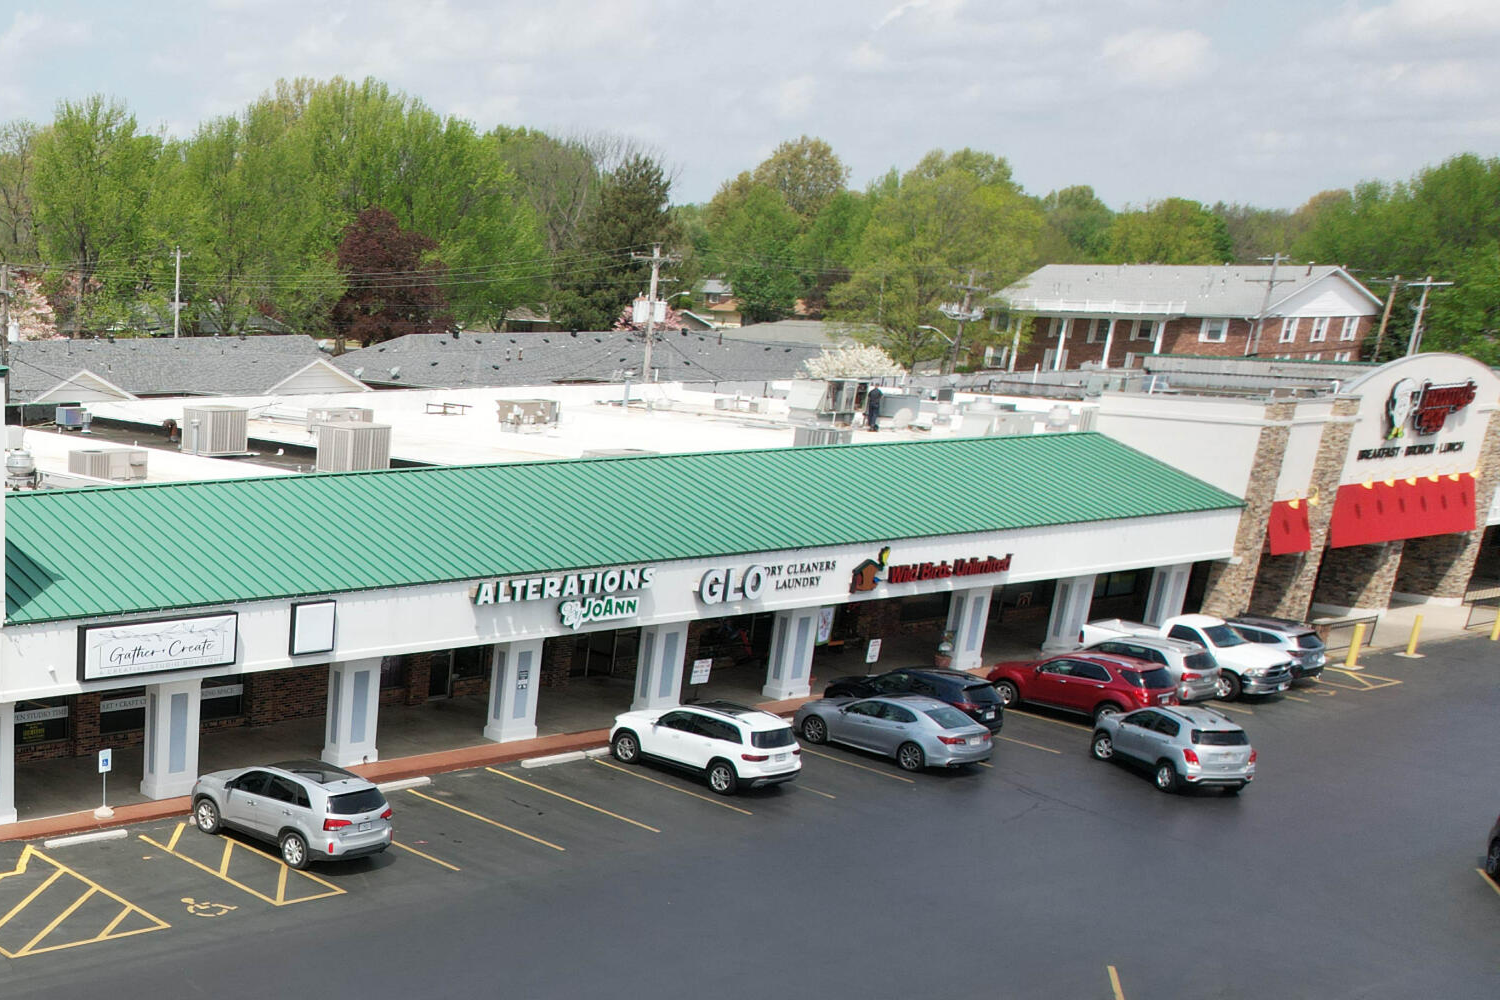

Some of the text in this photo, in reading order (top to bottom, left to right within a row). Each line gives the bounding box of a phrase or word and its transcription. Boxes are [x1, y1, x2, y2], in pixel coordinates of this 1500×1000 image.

[1357, 442, 1464, 460] BREAKFAST BRUNCH LUNCH
[700, 565, 767, 605] GLO
[787, 560, 837, 575] CLEANERS
[775, 576, 821, 590] LAUNDRY
[888, 553, 1014, 584] Wild Birds Unlimited
[476, 567, 657, 606] ALTERATIONS
[109, 638, 216, 665] Gather Create
